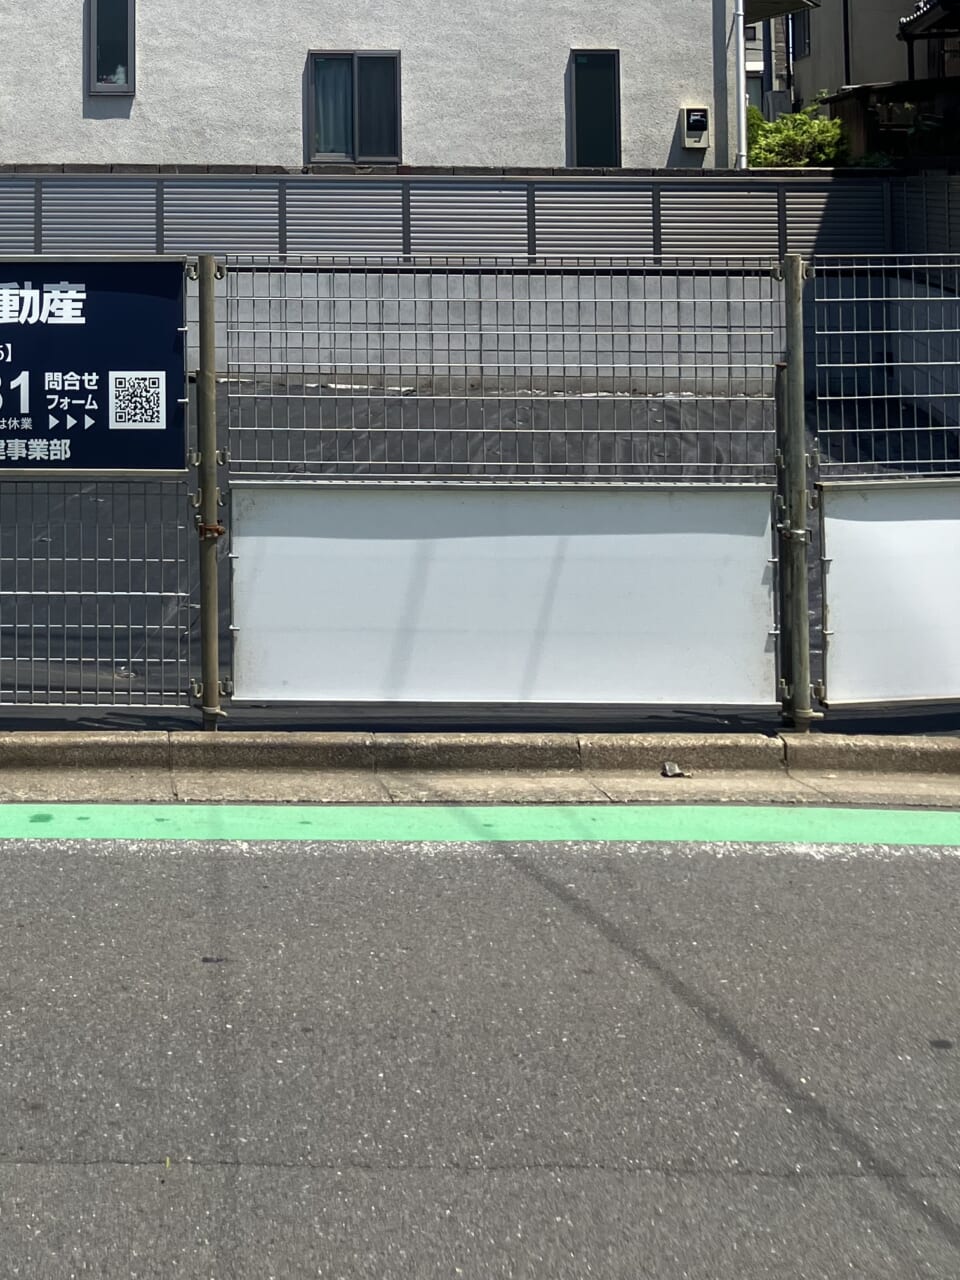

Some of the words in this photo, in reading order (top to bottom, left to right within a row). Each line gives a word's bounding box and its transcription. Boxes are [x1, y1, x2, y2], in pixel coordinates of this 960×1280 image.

[44, 371, 100, 391] 問合せ
[45, 394, 99, 411] フォーム
